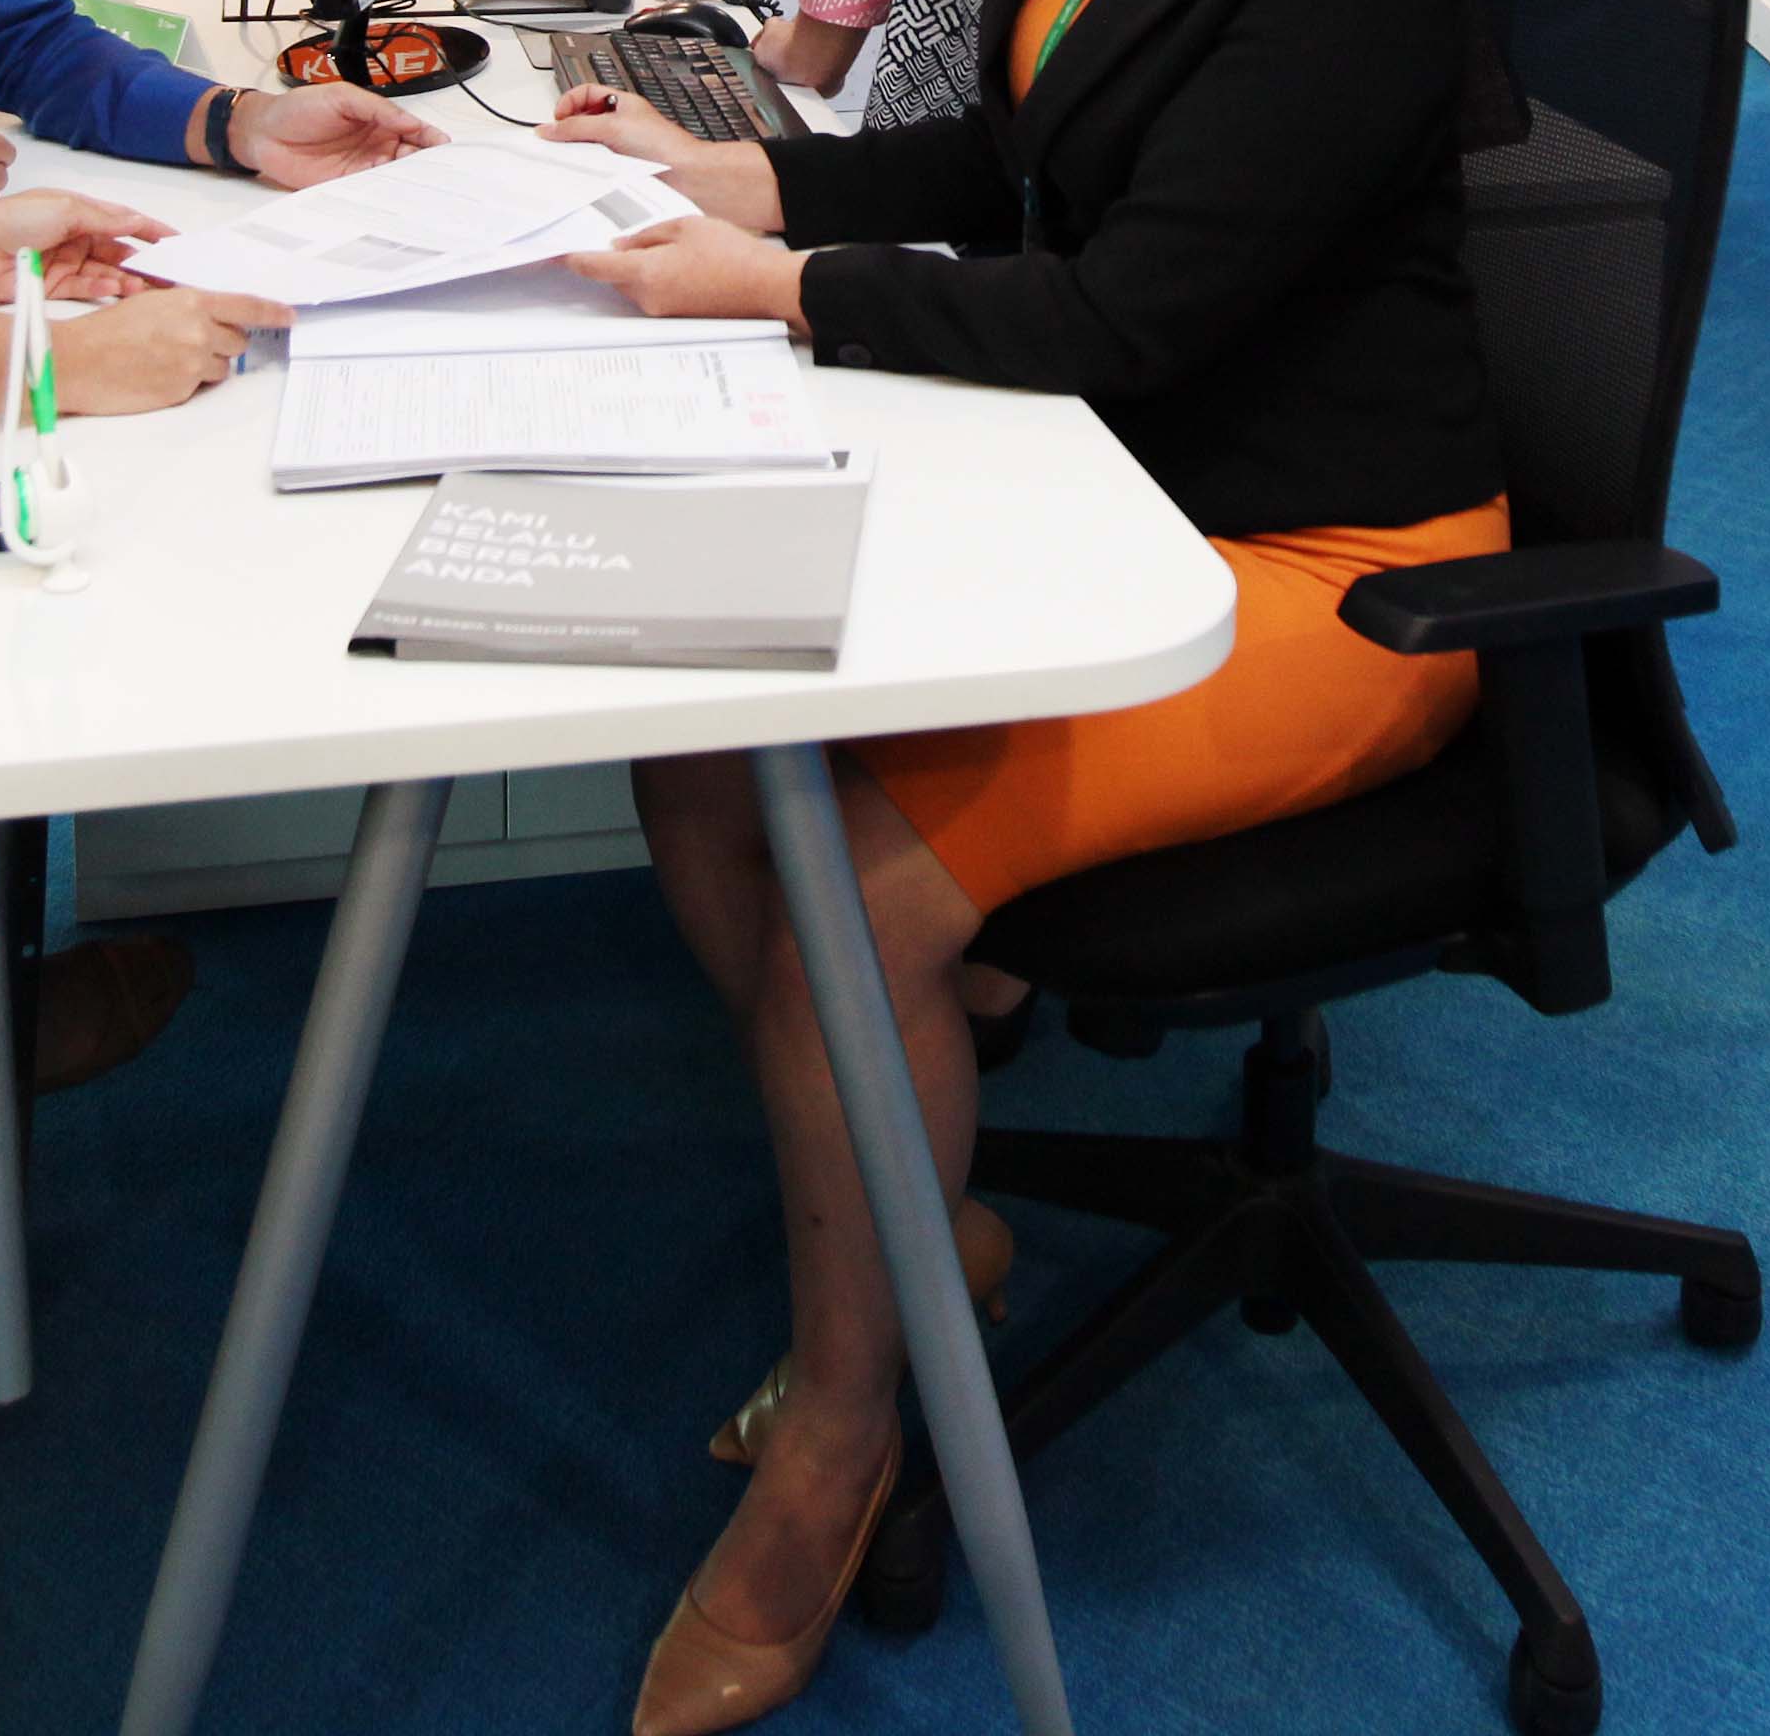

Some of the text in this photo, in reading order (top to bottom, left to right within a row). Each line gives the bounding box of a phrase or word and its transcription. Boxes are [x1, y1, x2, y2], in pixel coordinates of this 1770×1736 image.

[440, 501, 547, 529] KAMI
[431, 518, 596, 550] SELALU
[418, 535, 632, 570] BERSAMA
[404, 558, 534, 588] ANDA
